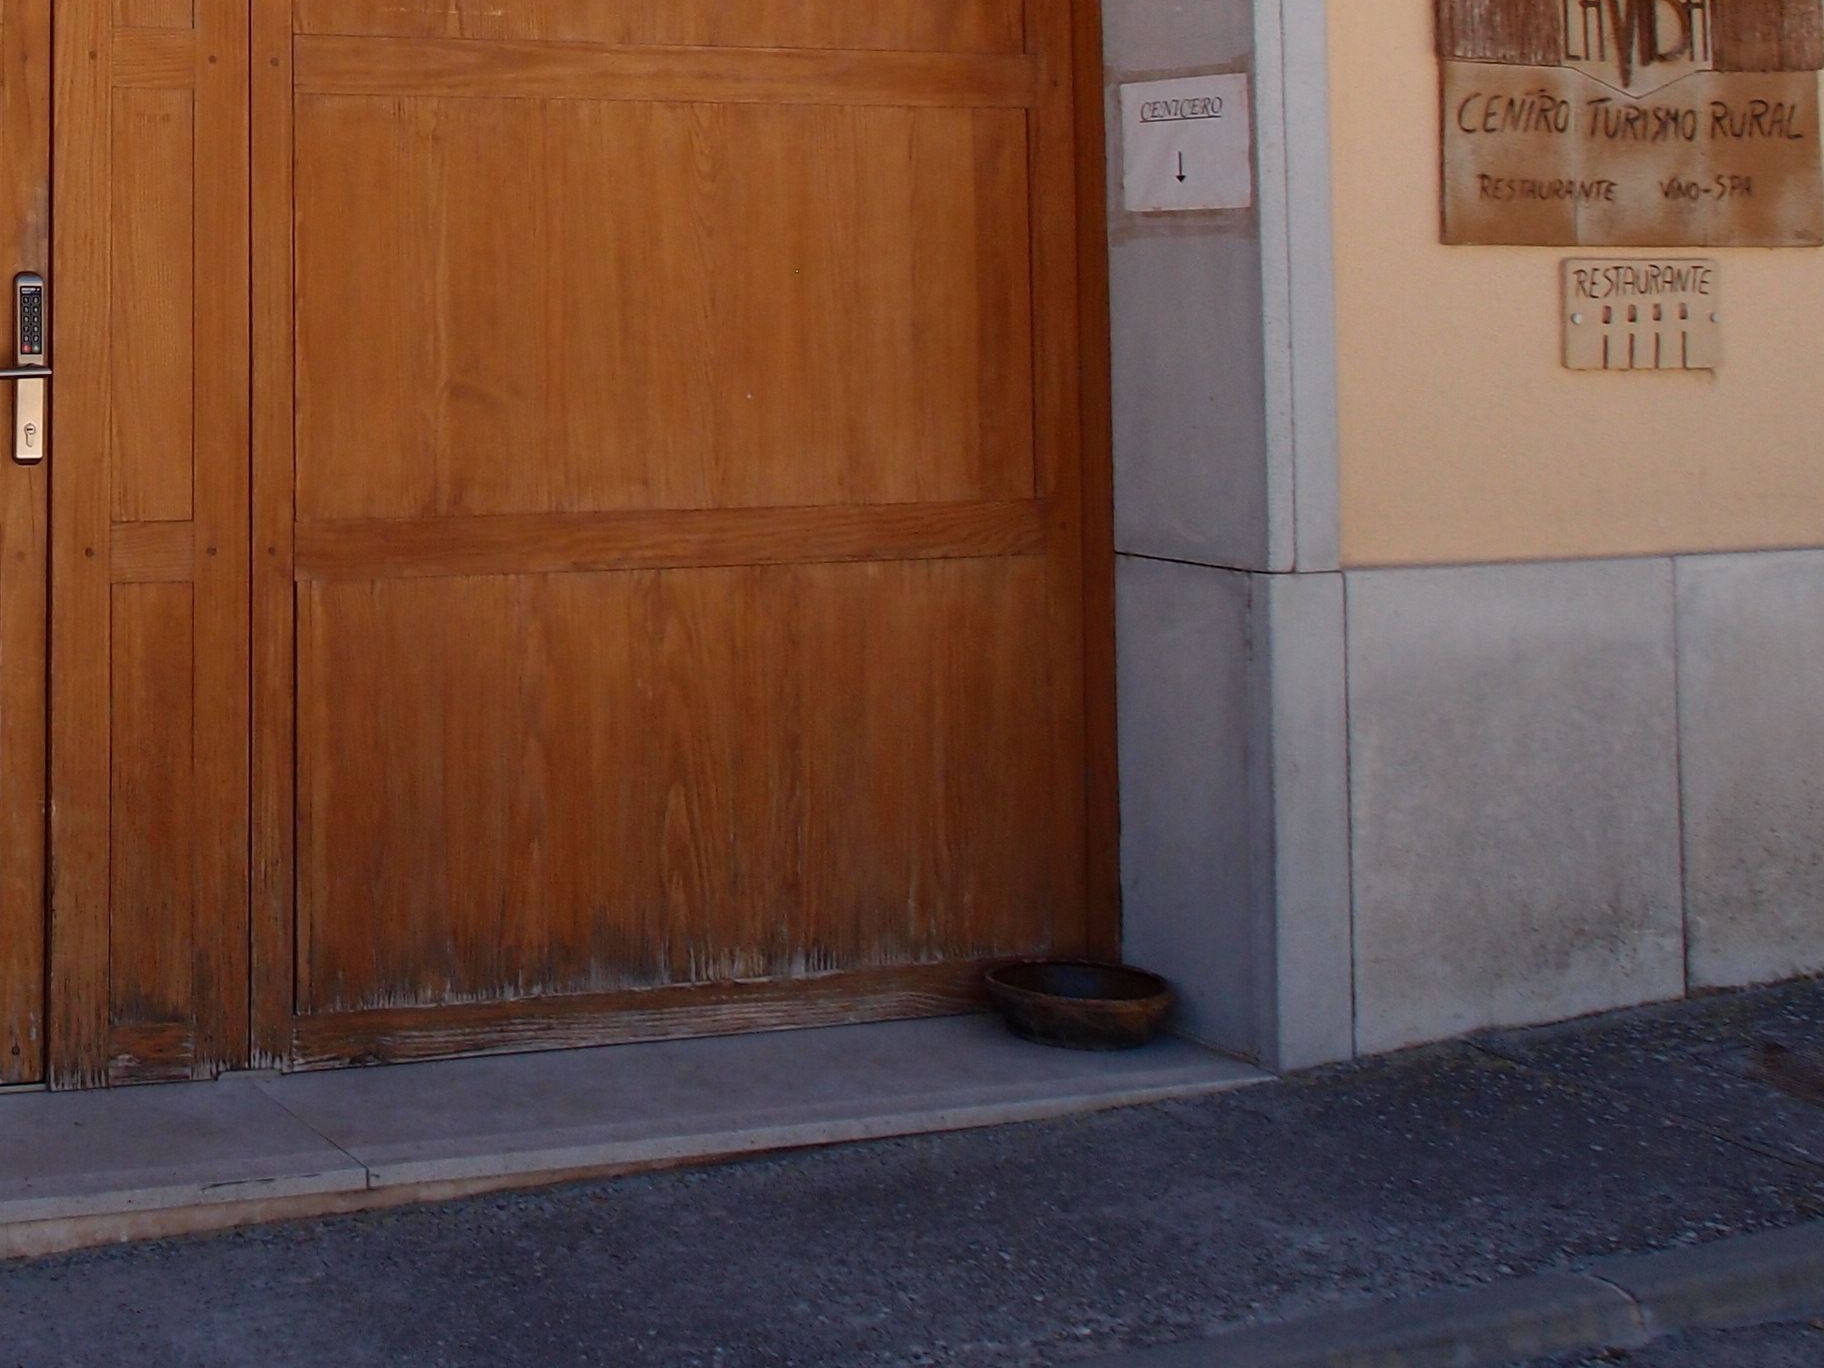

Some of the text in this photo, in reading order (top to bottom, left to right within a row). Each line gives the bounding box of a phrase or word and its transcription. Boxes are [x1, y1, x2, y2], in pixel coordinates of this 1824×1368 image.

[1140, 97, 1223, 120] CENICERO
[1458, 89, 1804, 142] CENTRO TURISMO RURAL
[1478, 173, 1618, 202] RESTAURANTE
[1573, 263, 1712, 299] RESTAURANTE
